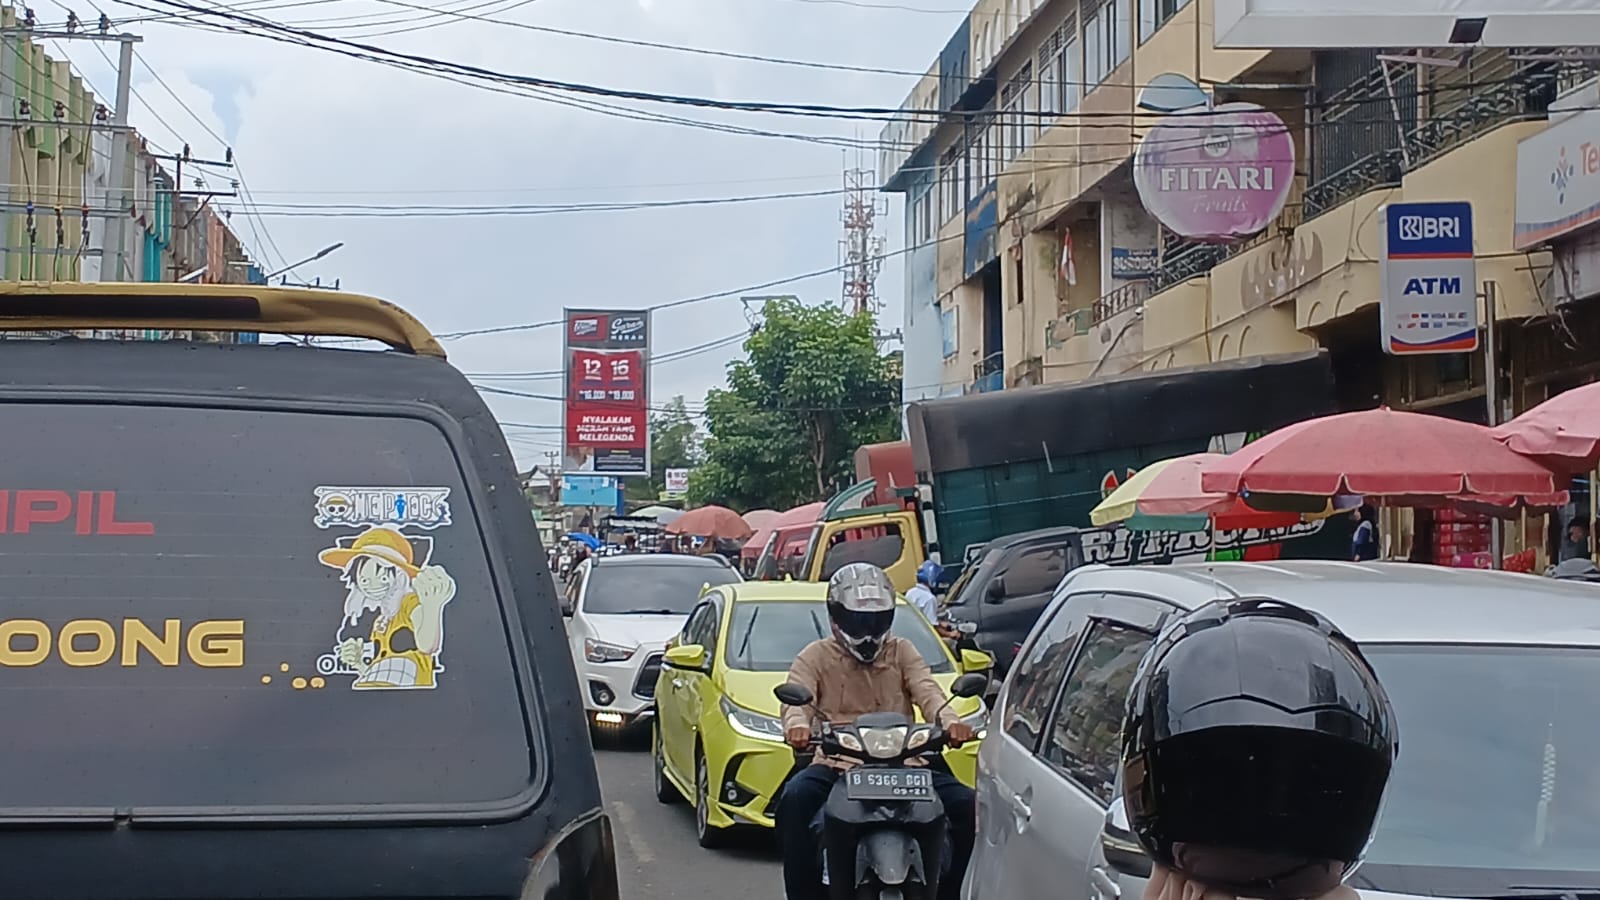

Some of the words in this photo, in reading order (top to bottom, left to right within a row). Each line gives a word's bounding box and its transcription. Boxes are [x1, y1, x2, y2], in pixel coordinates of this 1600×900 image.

[1579, 140, 1600, 177] Te
[1160, 167, 1274, 192] FITARI
[1424, 217, 1460, 239] BRI
[1403, 277, 1461, 296] ATM
[583, 359, 601, 375] 12
[610, 359, 629, 376] 16
[582, 415, 632, 424] NYALAKAN
[578, 433, 635, 442] MELEGENDA
[0, 490, 154, 535] PIL
[853, 773, 861, 785] B
